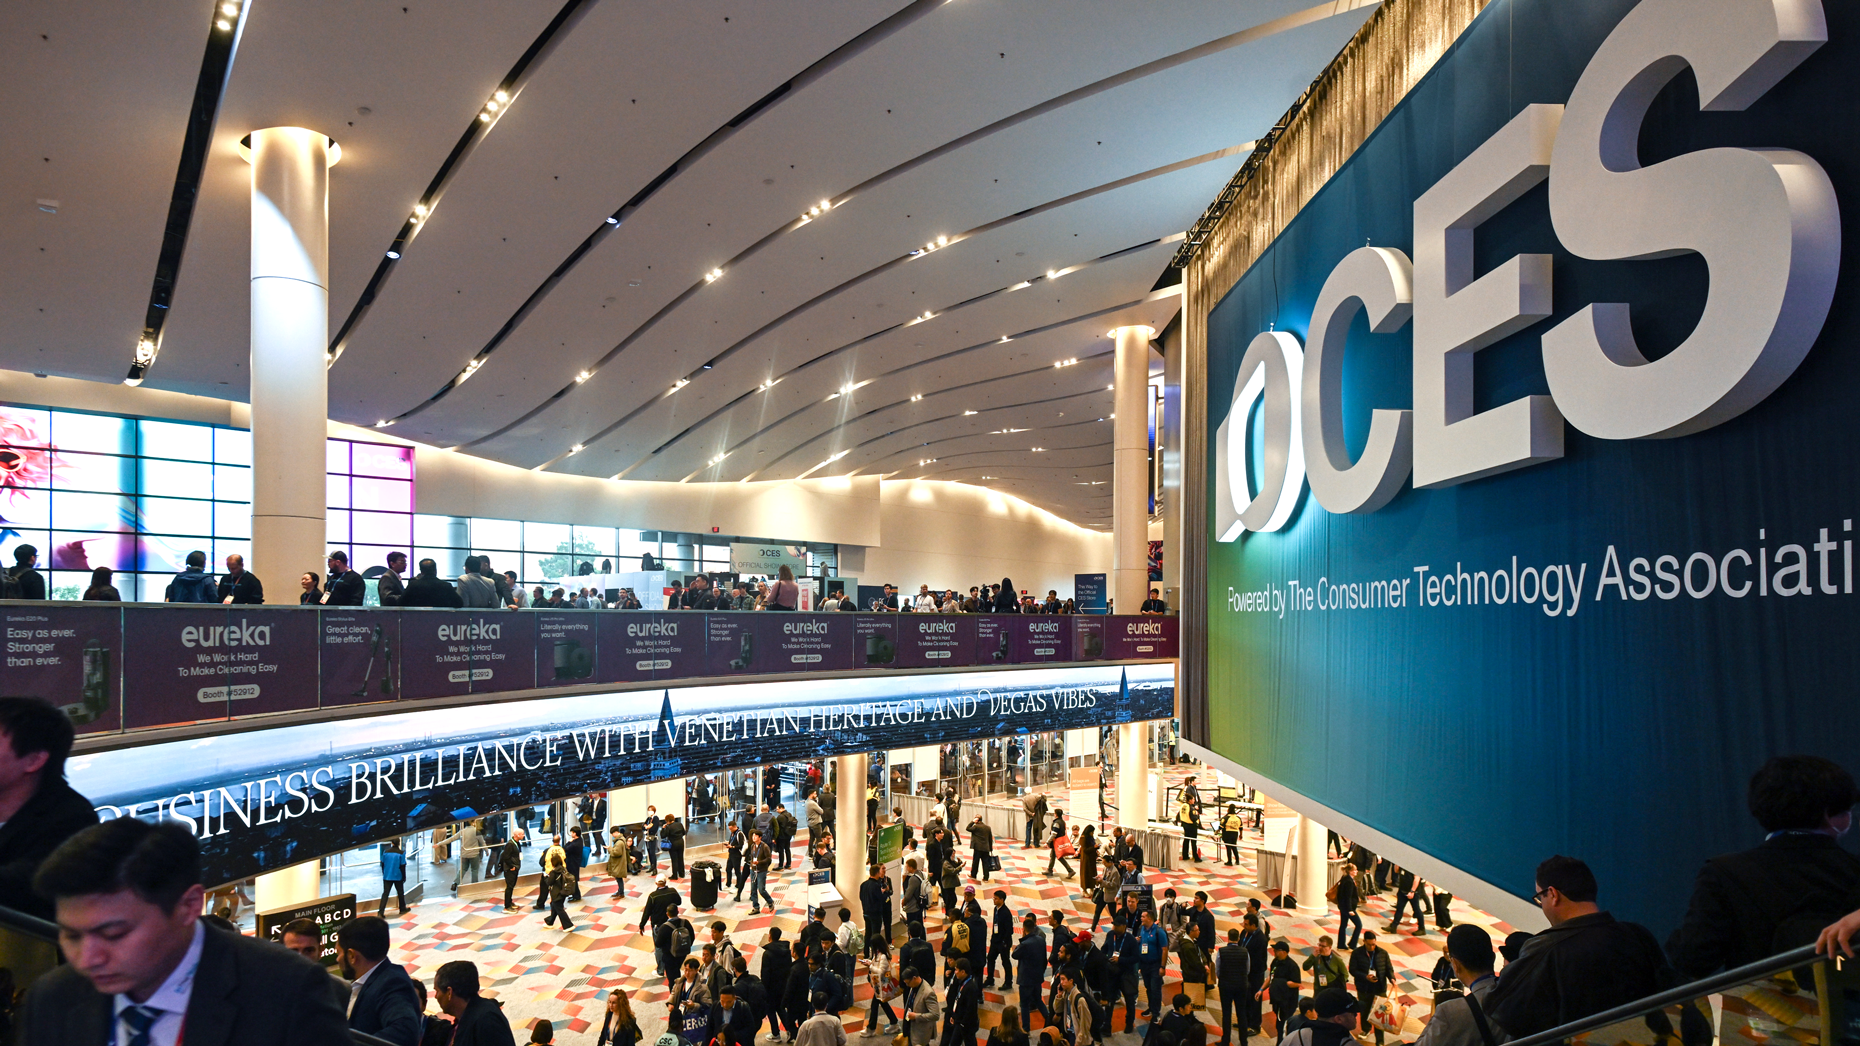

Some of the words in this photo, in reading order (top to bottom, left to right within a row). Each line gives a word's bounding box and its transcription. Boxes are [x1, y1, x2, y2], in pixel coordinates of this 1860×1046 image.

[1303, 0, 1842, 514] CES
[765, 549, 780, 557] CES
[737, 561, 762, 569] OFFICIAL
[1228, 583, 1270, 612] Powered
[1272, 586, 1286, 619] by
[1288, 580, 1313, 611] The
[1317, 577, 1410, 610] Consumer
[1413, 555, 1587, 617] Technology
[1595, 519, 1853, 601] Associati
[326, 625, 347, 634] Great
[349, 626, 371, 634] clean,
[437, 618, 500, 641] eureka
[627, 618, 678, 637] eureka
[783, 619, 827, 634] eureka
[919, 619, 956, 633] eureka
[1029, 619, 1059, 632] eureka
[1127, 619, 1161, 634] eureka
[7, 628, 33, 640] Easy
[36, 629, 49, 638] as
[51, 629, 76, 637] ever.
[181, 618, 270, 648] eureka
[343, 635, 364, 643] effort.
[7, 642, 55, 653] Stronger
[7, 657, 33, 667] than
[36, 657, 61, 665] ever.
[197, 654, 211, 663] We
[212, 652, 236, 662] Work
[237, 652, 259, 661] Hard
[462, 653, 491, 661] Claning
[178, 667, 189, 676] To
[191, 667, 215, 676] Make
[258, 663, 278, 673] Easy
[203, 691, 224, 699] Booth
[94, 766, 335, 839] SINESS
[348, 730, 562, 805] BRILLIANCE
[569, 722, 654, 762] WITH
[663, 709, 804, 749] VENETIAN
[809, 702, 926, 732] HERITAGE
[934, 695, 976, 721] AND
[977, 689, 1047, 716] VEGAS
[1053, 687, 1096, 710] VIBES
[294, 908, 312, 918] MAIN
[313, 904, 336, 914] FLOOR
[659, 1037, 673, 1045] CSC
